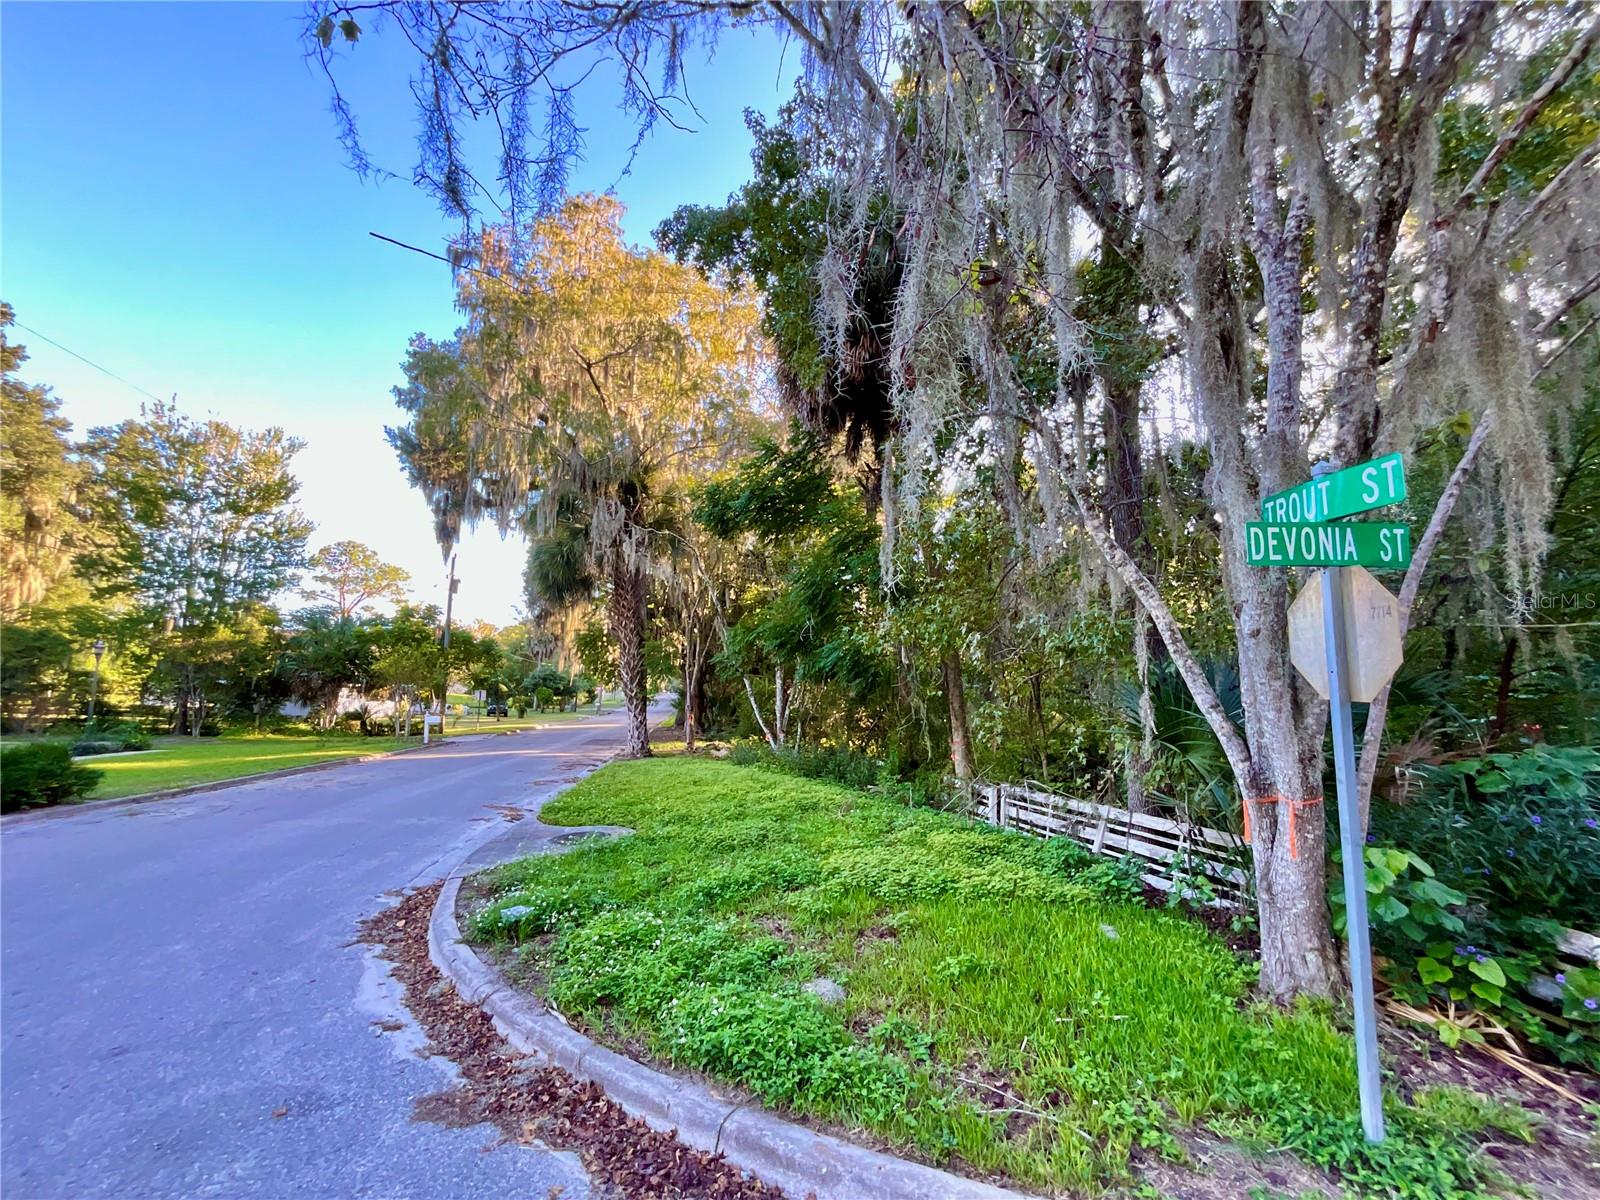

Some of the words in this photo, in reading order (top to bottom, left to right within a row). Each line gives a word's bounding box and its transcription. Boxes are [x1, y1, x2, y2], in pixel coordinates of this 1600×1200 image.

[1264, 480, 1330, 523] TROUT
[1361, 459, 1398, 504] ST
[1250, 526, 1358, 561] DEVONIA
[1379, 528, 1405, 562] ST
